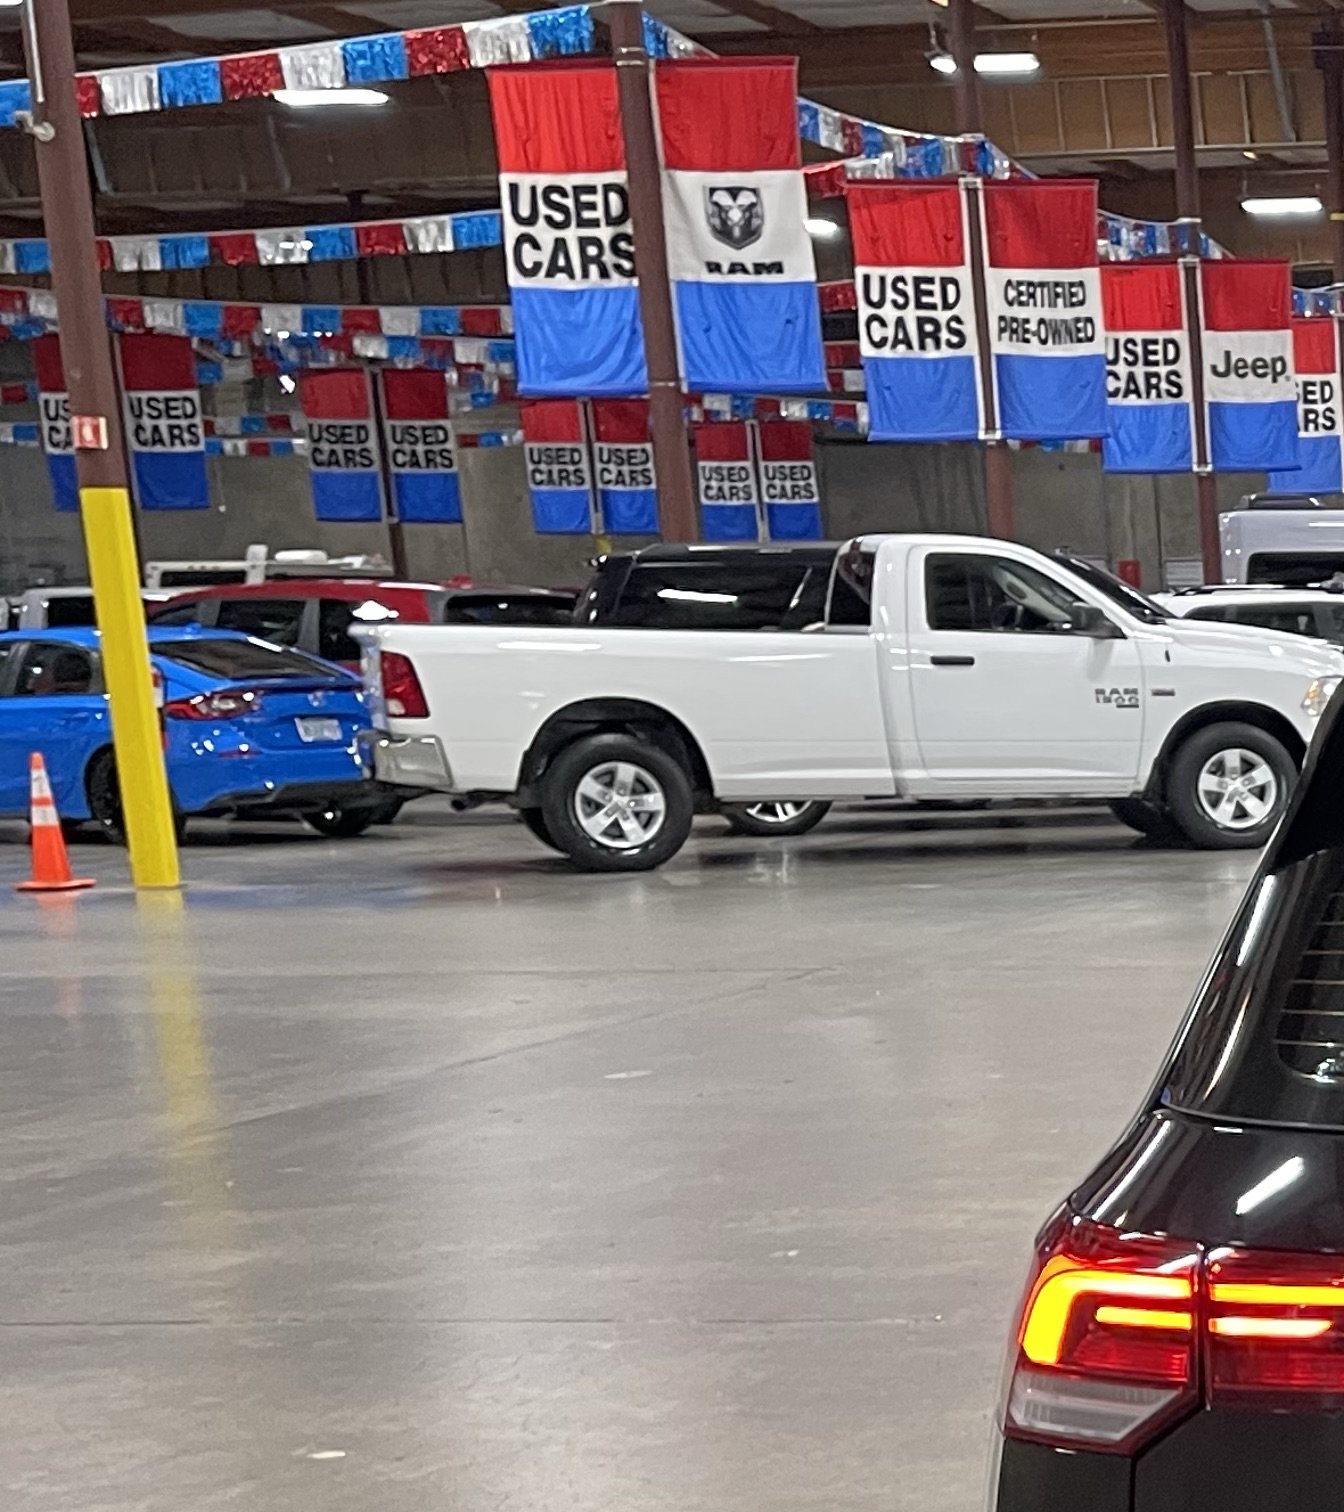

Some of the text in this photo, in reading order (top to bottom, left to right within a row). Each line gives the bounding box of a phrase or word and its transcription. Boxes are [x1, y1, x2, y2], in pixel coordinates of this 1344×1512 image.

[508, 182, 629, 229] USED
[512, 232, 636, 280] CARS
[704, 260, 785, 275] RAM
[862, 274, 961, 312] USED
[1004, 279, 1087, 309] CERTIFIED
[864, 313, 968, 351] CARS
[997, 315, 1096, 346] PRE-OWNED
[1105, 337, 1181, 367] USED
[1210, 350, 1288, 384] Jeep
[1106, 369, 1184, 400] CARS
[1295, 380, 1334, 405] ED
[129, 395, 198, 420] USED
[1296, 406, 1337, 433] RS
[134, 423, 201, 448] CARS
[308, 423, 369, 445] USED
[390, 424, 449, 446] USED
[311, 447, 374, 469] CARS
[392, 448, 454, 470] CARS
[528, 447, 583, 466] USED
[598, 447, 650, 467] USED
[530, 467, 586, 487] CARS
[600, 467, 653, 487] CARS
[701, 465, 750, 482] USED
[764, 464, 812, 482] USED
[703, 484, 753, 501] CARS
[765, 483, 815, 501] CARS
